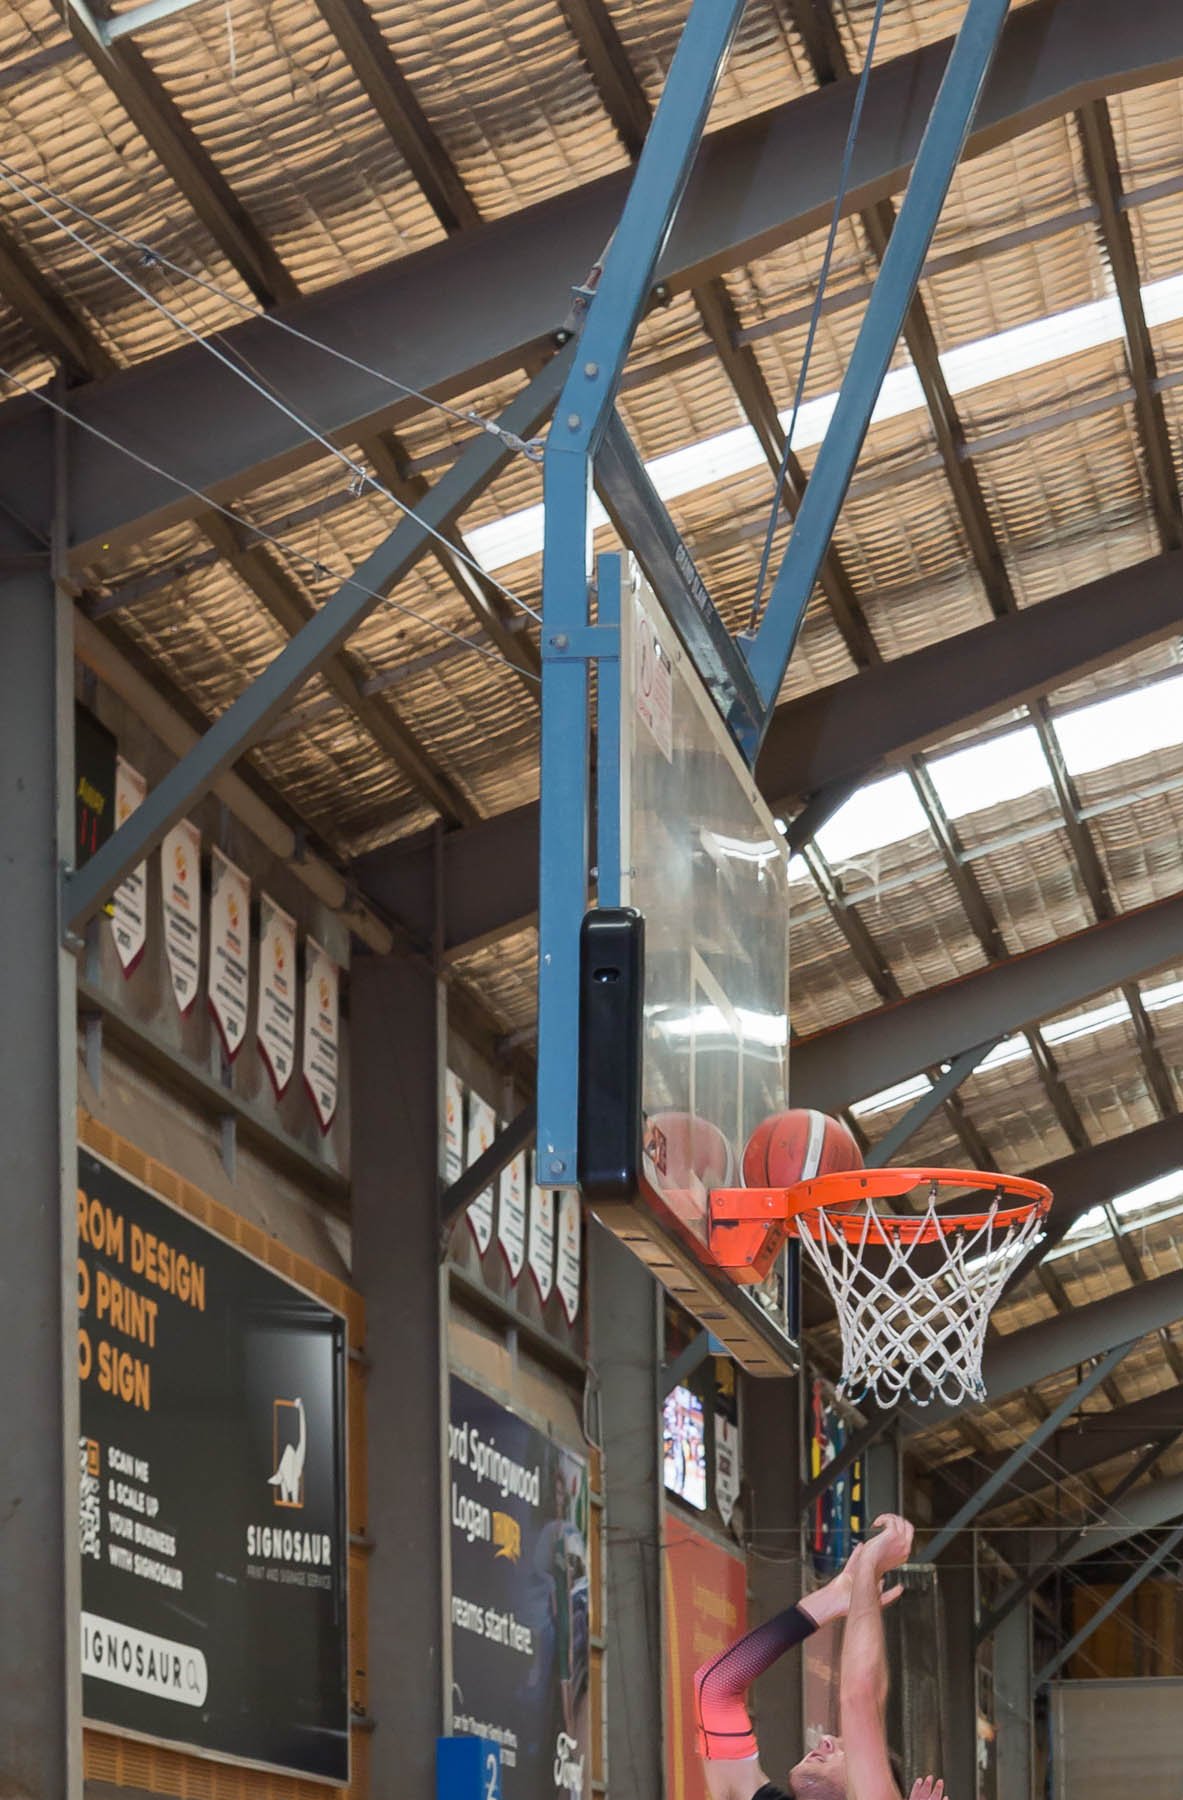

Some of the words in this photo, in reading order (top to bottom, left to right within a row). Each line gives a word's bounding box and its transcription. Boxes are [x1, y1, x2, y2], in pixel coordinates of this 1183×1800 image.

[130, 1223, 205, 1312] DESIGN
[96, 1271, 158, 1348] PRINT
[98, 1341, 149, 1412] SIGN
[470, 1428, 540, 1507] Springwood
[247, 1524, 331, 1566] SIGNOSAUR
[452, 1482, 491, 1543] Logan
[84, 1627, 183, 1690] IGNOSAUR
